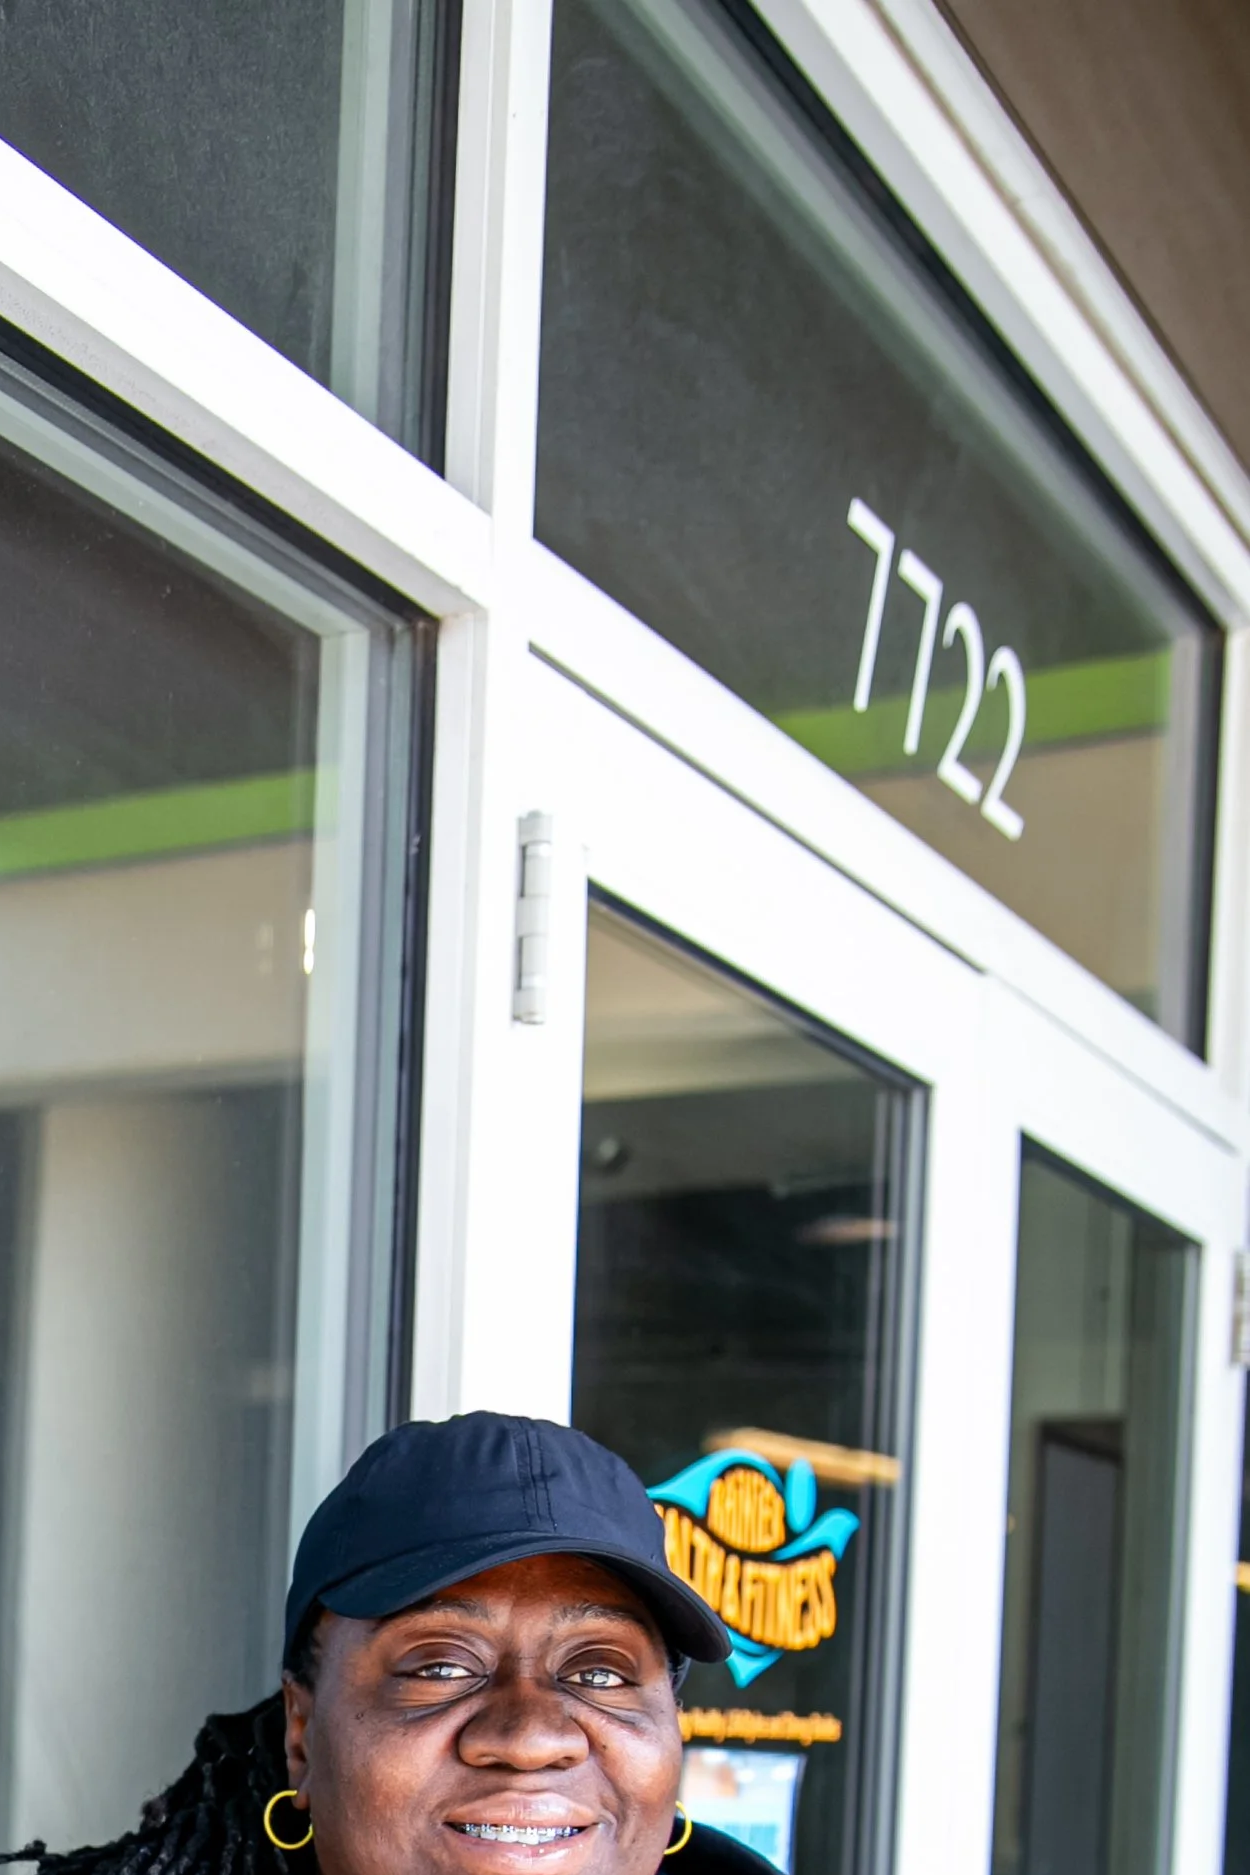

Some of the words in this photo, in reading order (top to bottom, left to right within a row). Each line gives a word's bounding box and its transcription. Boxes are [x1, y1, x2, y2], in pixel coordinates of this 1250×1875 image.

[847, 497, 1026, 842] 7722
[653, 1504, 727, 1613] ALTH
[740, 1550, 837, 1650] FITNESS
